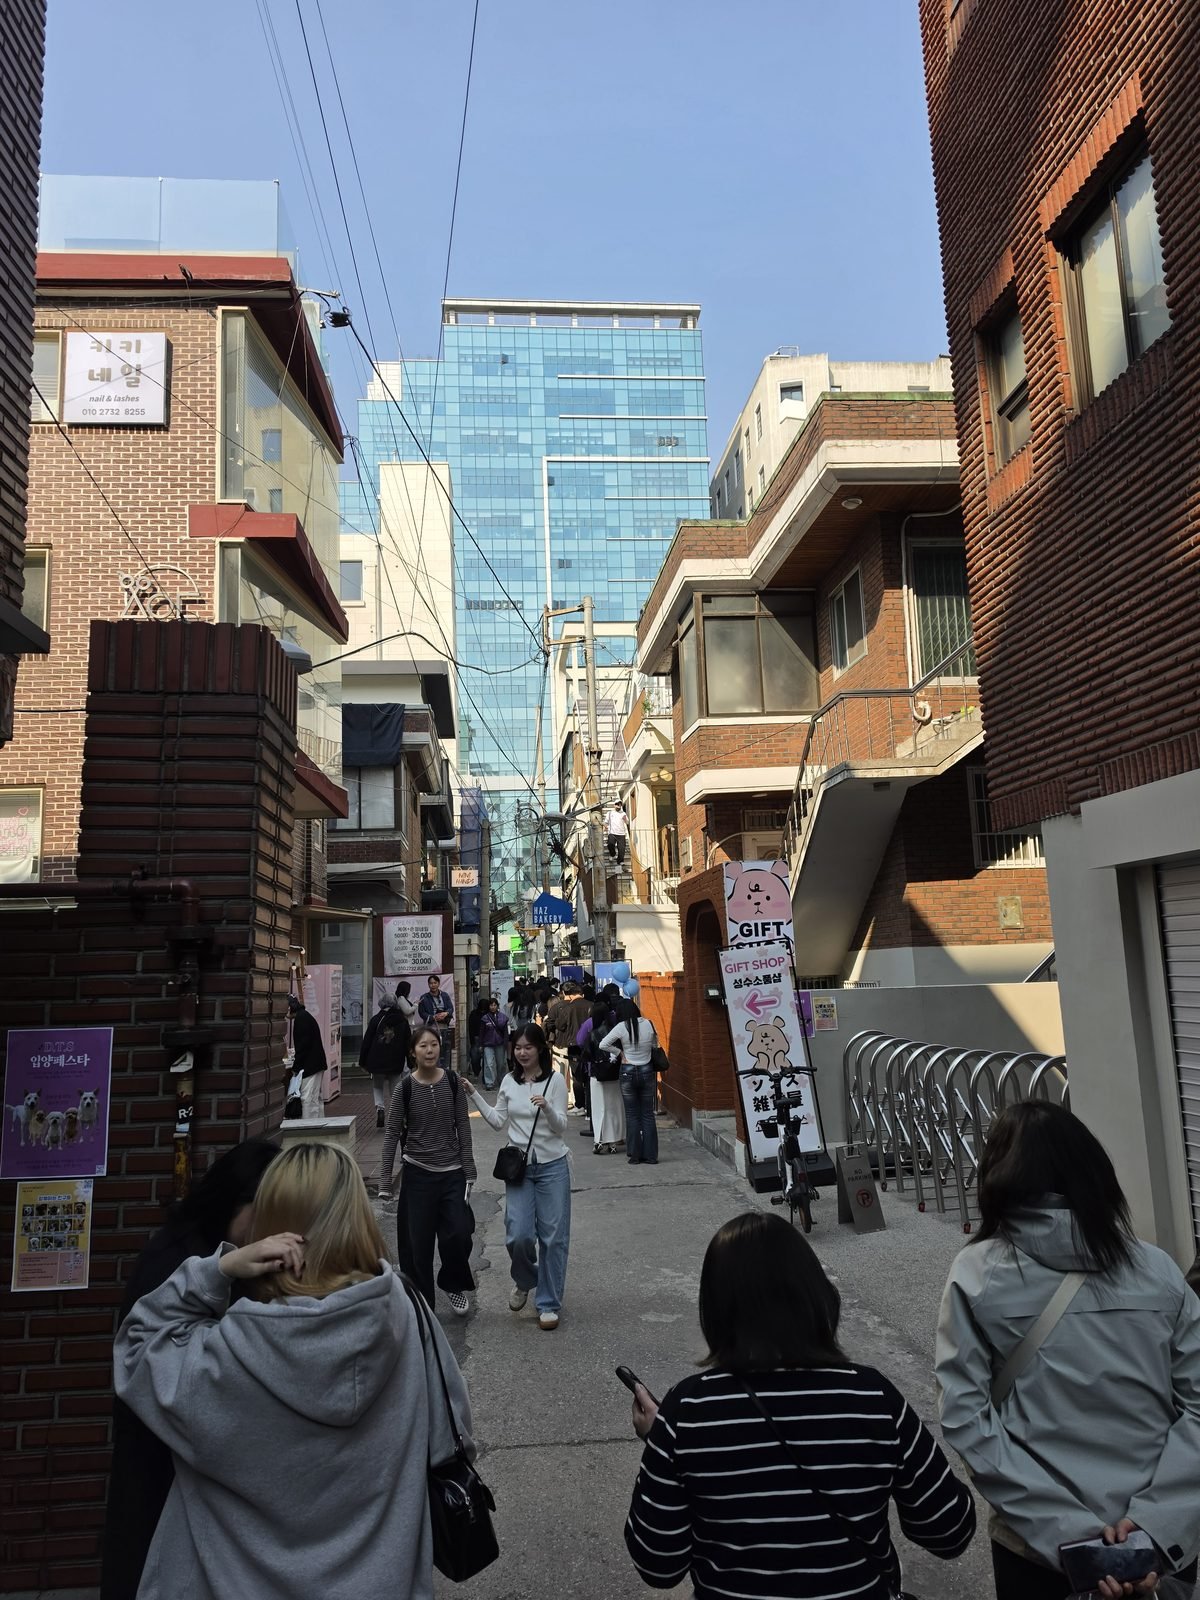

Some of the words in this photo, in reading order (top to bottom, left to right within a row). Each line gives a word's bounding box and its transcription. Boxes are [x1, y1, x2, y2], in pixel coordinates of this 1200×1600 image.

[88, 364, 141, 388] 네일
[89, 394, 105, 402] nail
[113, 394, 140, 402] lashes
[82, 408, 97, 416] 010
[99, 408, 120, 416] 2732
[124, 408, 146, 416] 8255
[533, 906, 548, 915] HAZ
[533, 915, 562, 923] BAKERY
[739, 921, 784, 938] GIFT
[724, 961, 750, 974] GIFT
[751, 956, 785, 971] SHOP
[733, 972, 782, 989] 성수소품샵
[30, 1053, 91, 1068] 입양페스타
